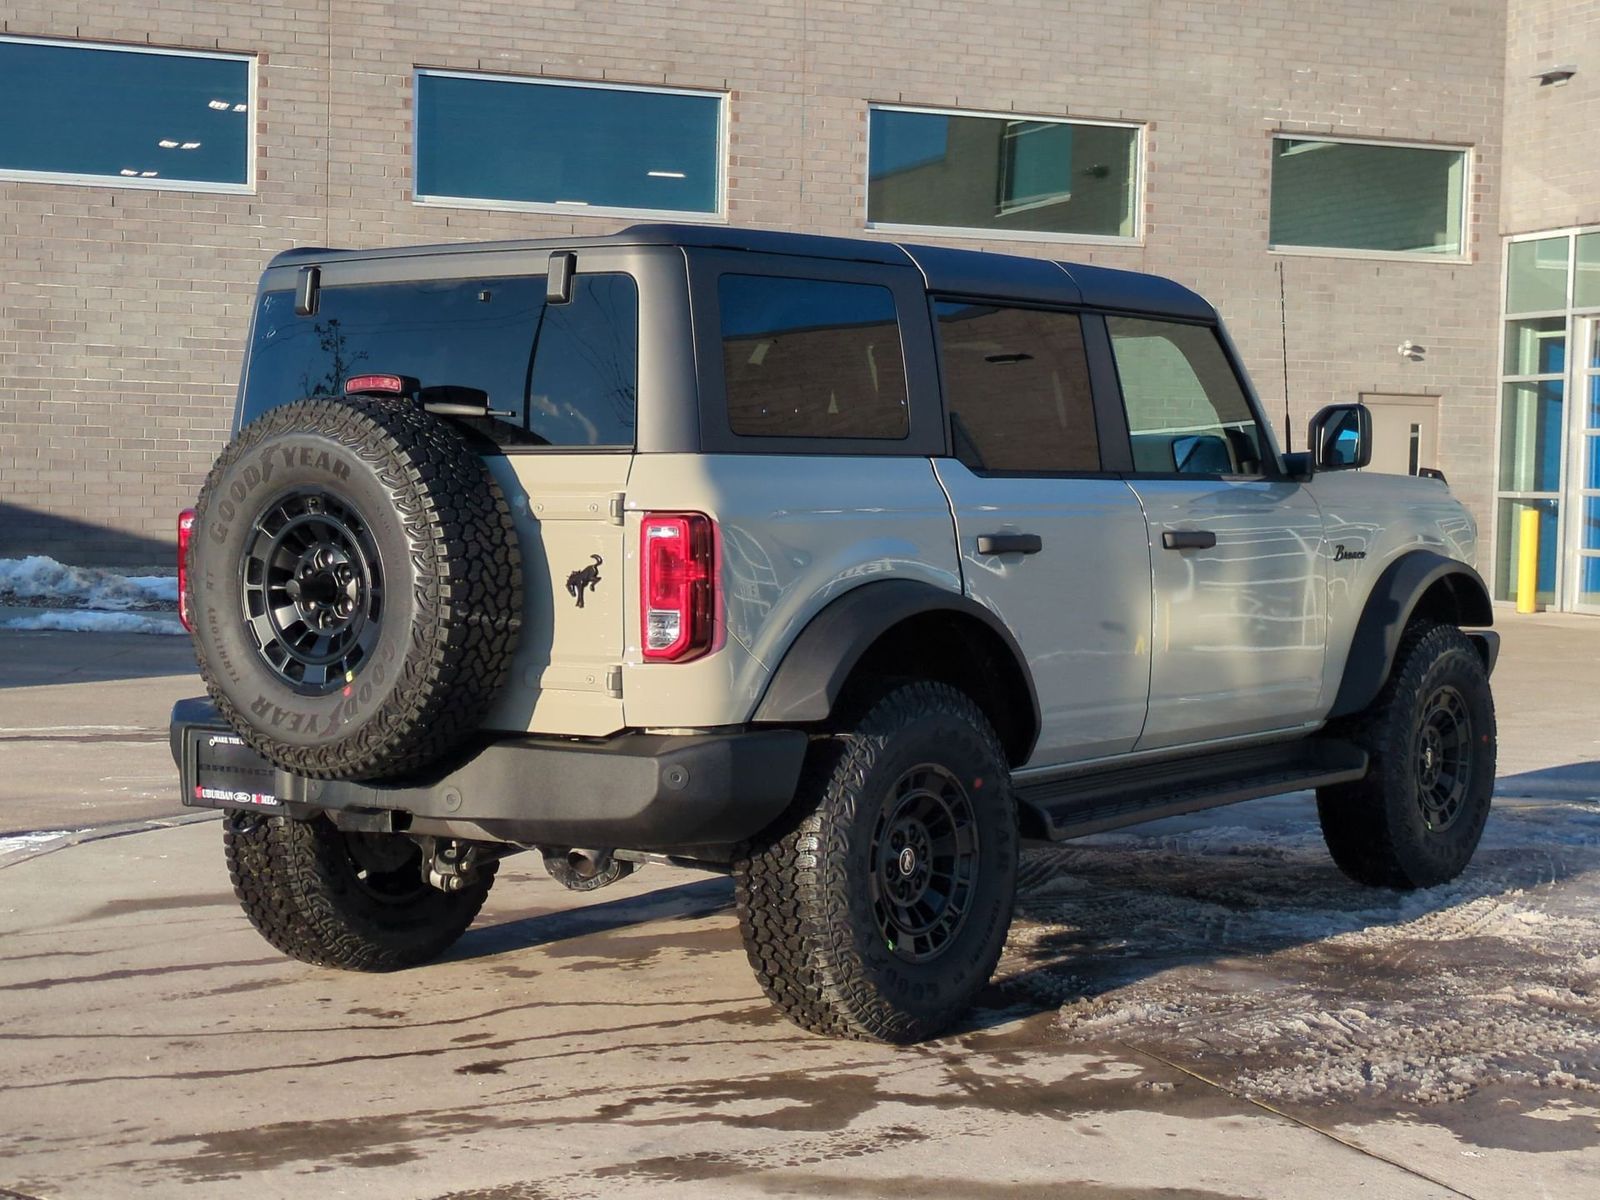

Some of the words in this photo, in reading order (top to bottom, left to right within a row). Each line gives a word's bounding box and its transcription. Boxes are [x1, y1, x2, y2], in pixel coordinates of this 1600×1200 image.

[209, 442, 351, 545] GOODYEAR
[1333, 544, 1367, 562] Bronco
[250, 640, 396, 738] GOODYEAR
